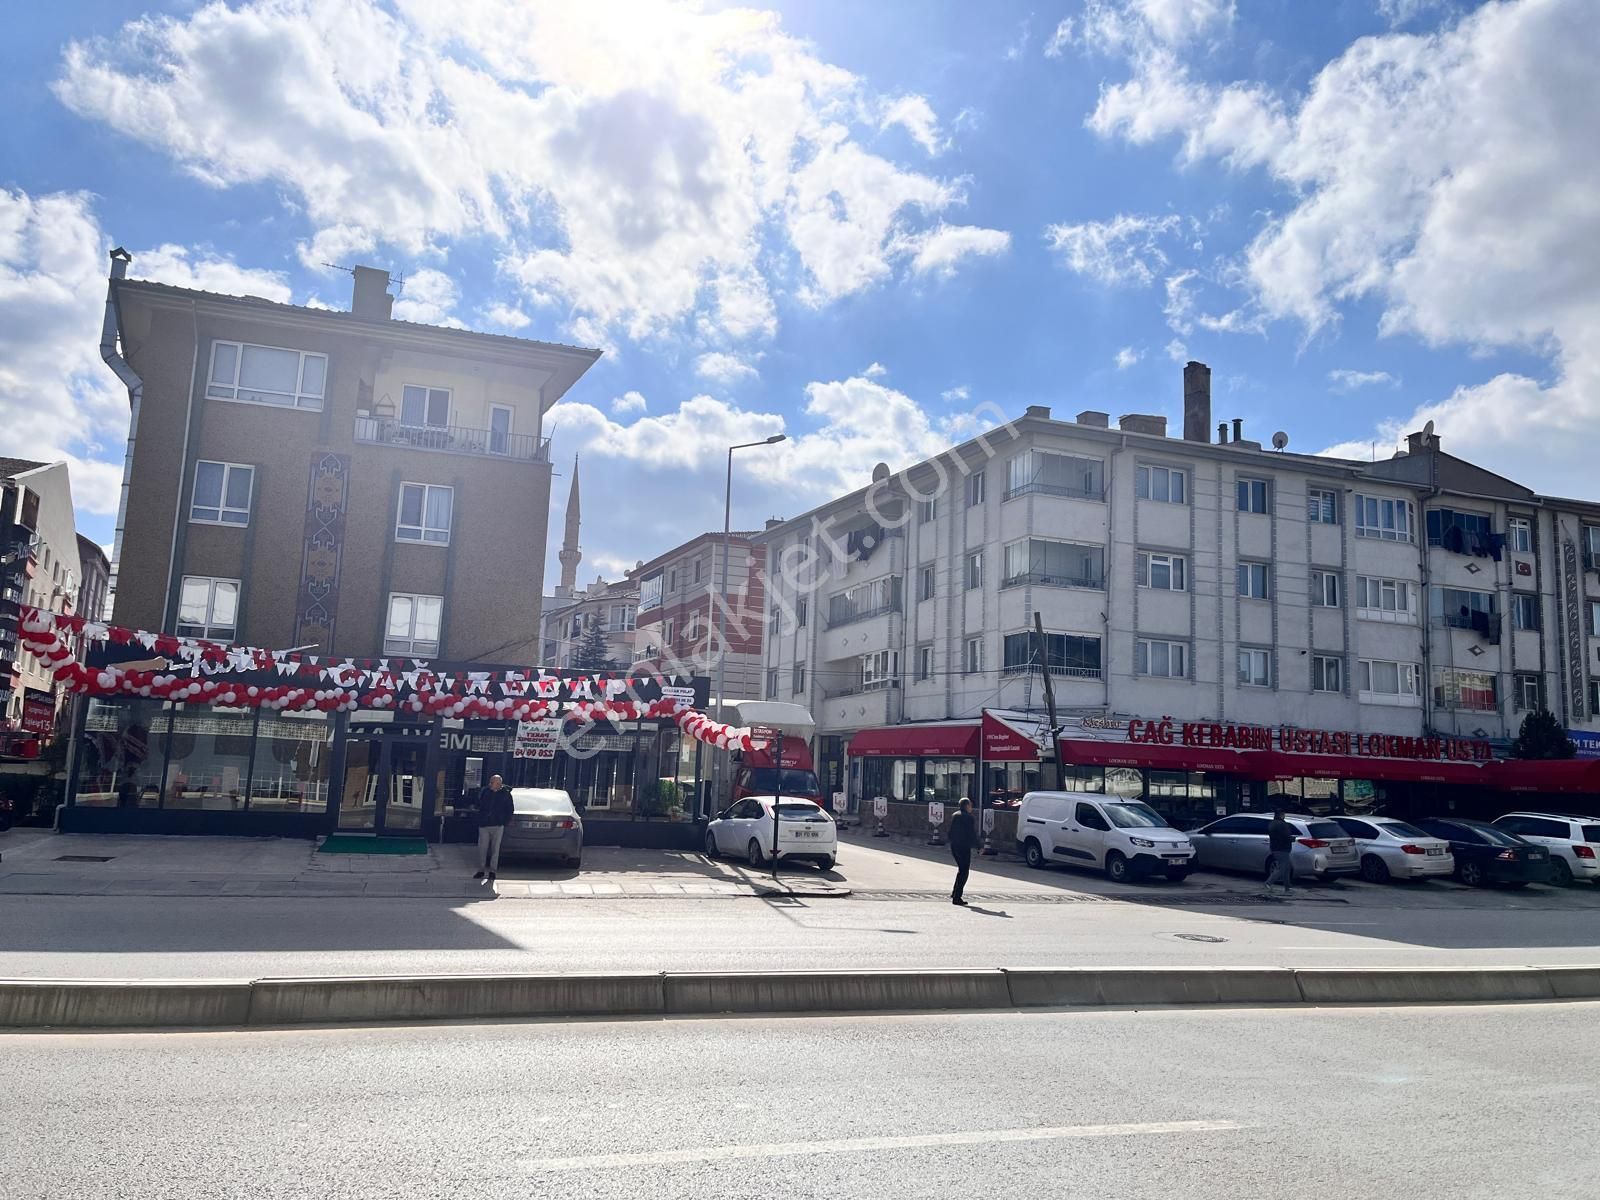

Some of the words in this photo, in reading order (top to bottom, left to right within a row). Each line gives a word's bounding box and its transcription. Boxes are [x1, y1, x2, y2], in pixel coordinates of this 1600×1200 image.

[1128, 716, 1174, 745] CAĞ
[1181, 722, 1272, 751] KEBABIN
[1279, 728, 1351, 755] USTASI
[1355, 733, 1442, 760] LOKMAN
[1446, 740, 1493, 761] USTA
